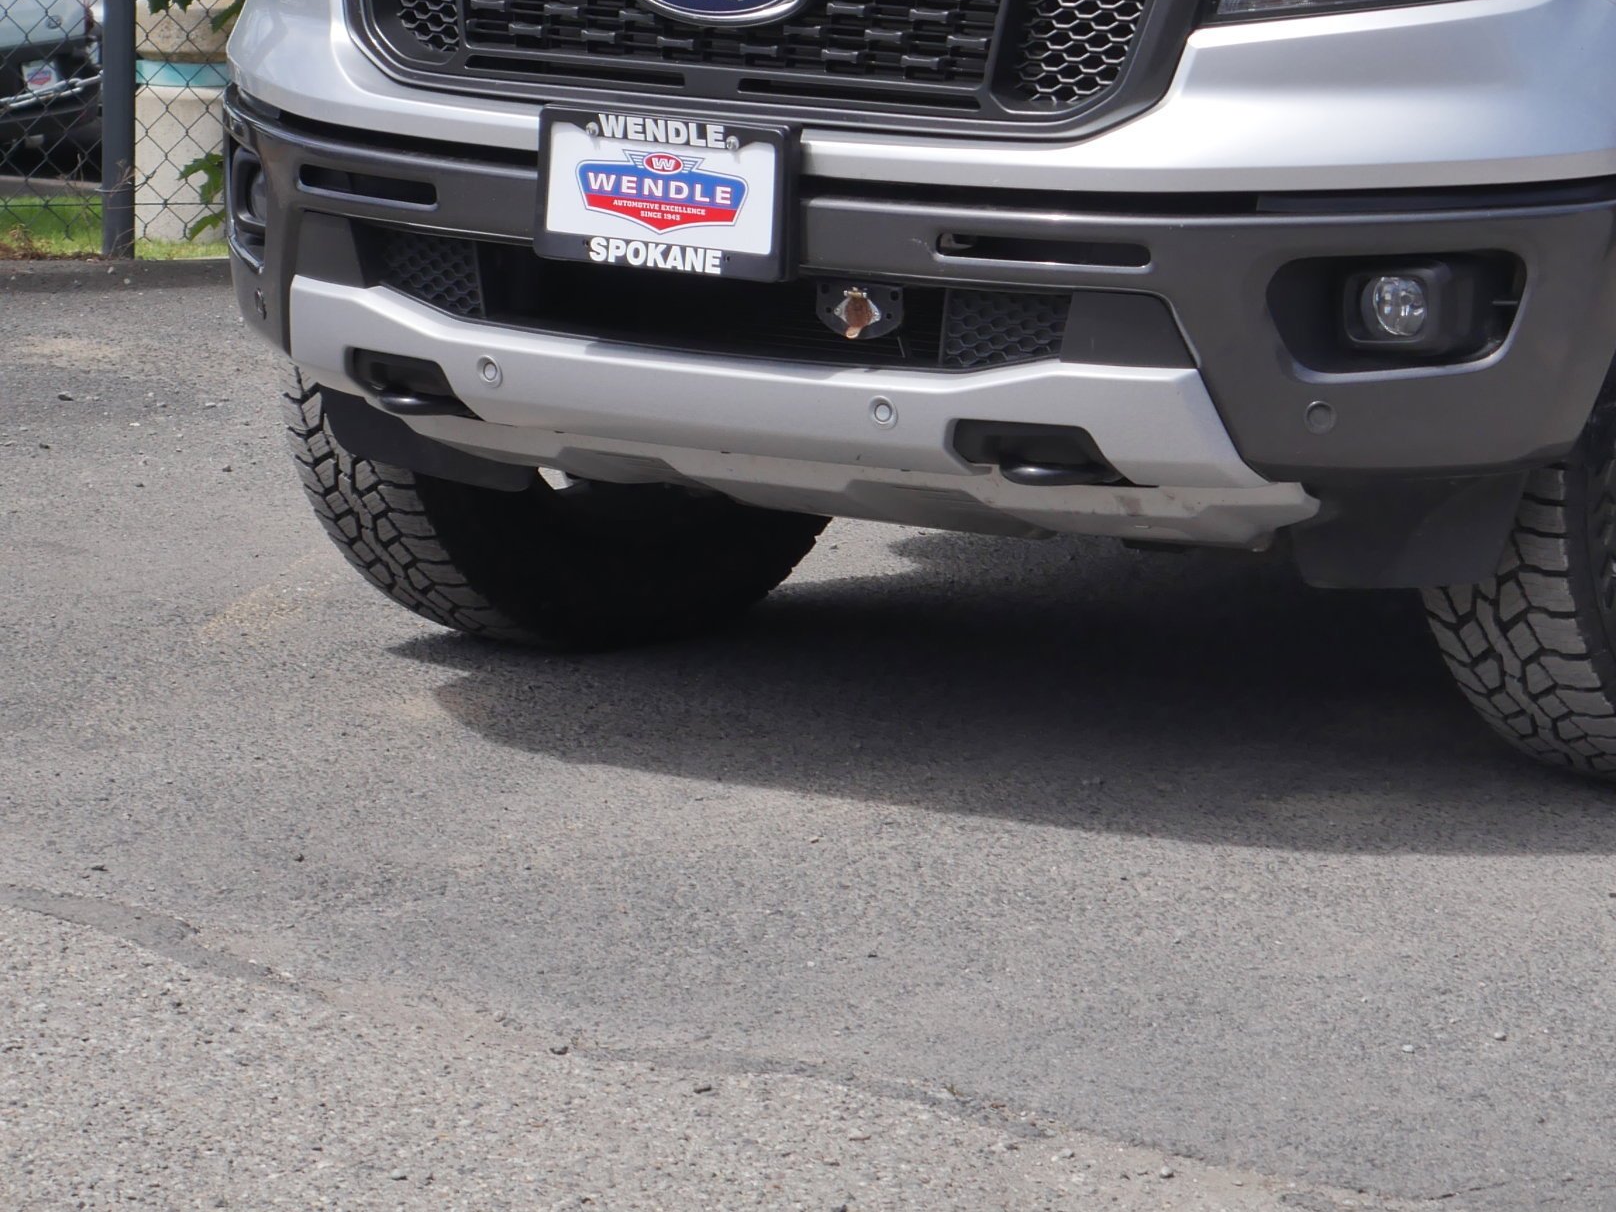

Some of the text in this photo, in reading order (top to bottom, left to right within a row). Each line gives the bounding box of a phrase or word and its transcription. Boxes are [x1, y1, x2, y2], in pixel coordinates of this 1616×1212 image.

[598, 113, 726, 149] WENDLE
[587, 171, 732, 205] WENDLE
[613, 199, 706, 215] AUTOMOTIVE EXCELLENCE
[640, 210, 681, 221] SINCE 1943
[589, 237, 722, 275] SPOKANE
